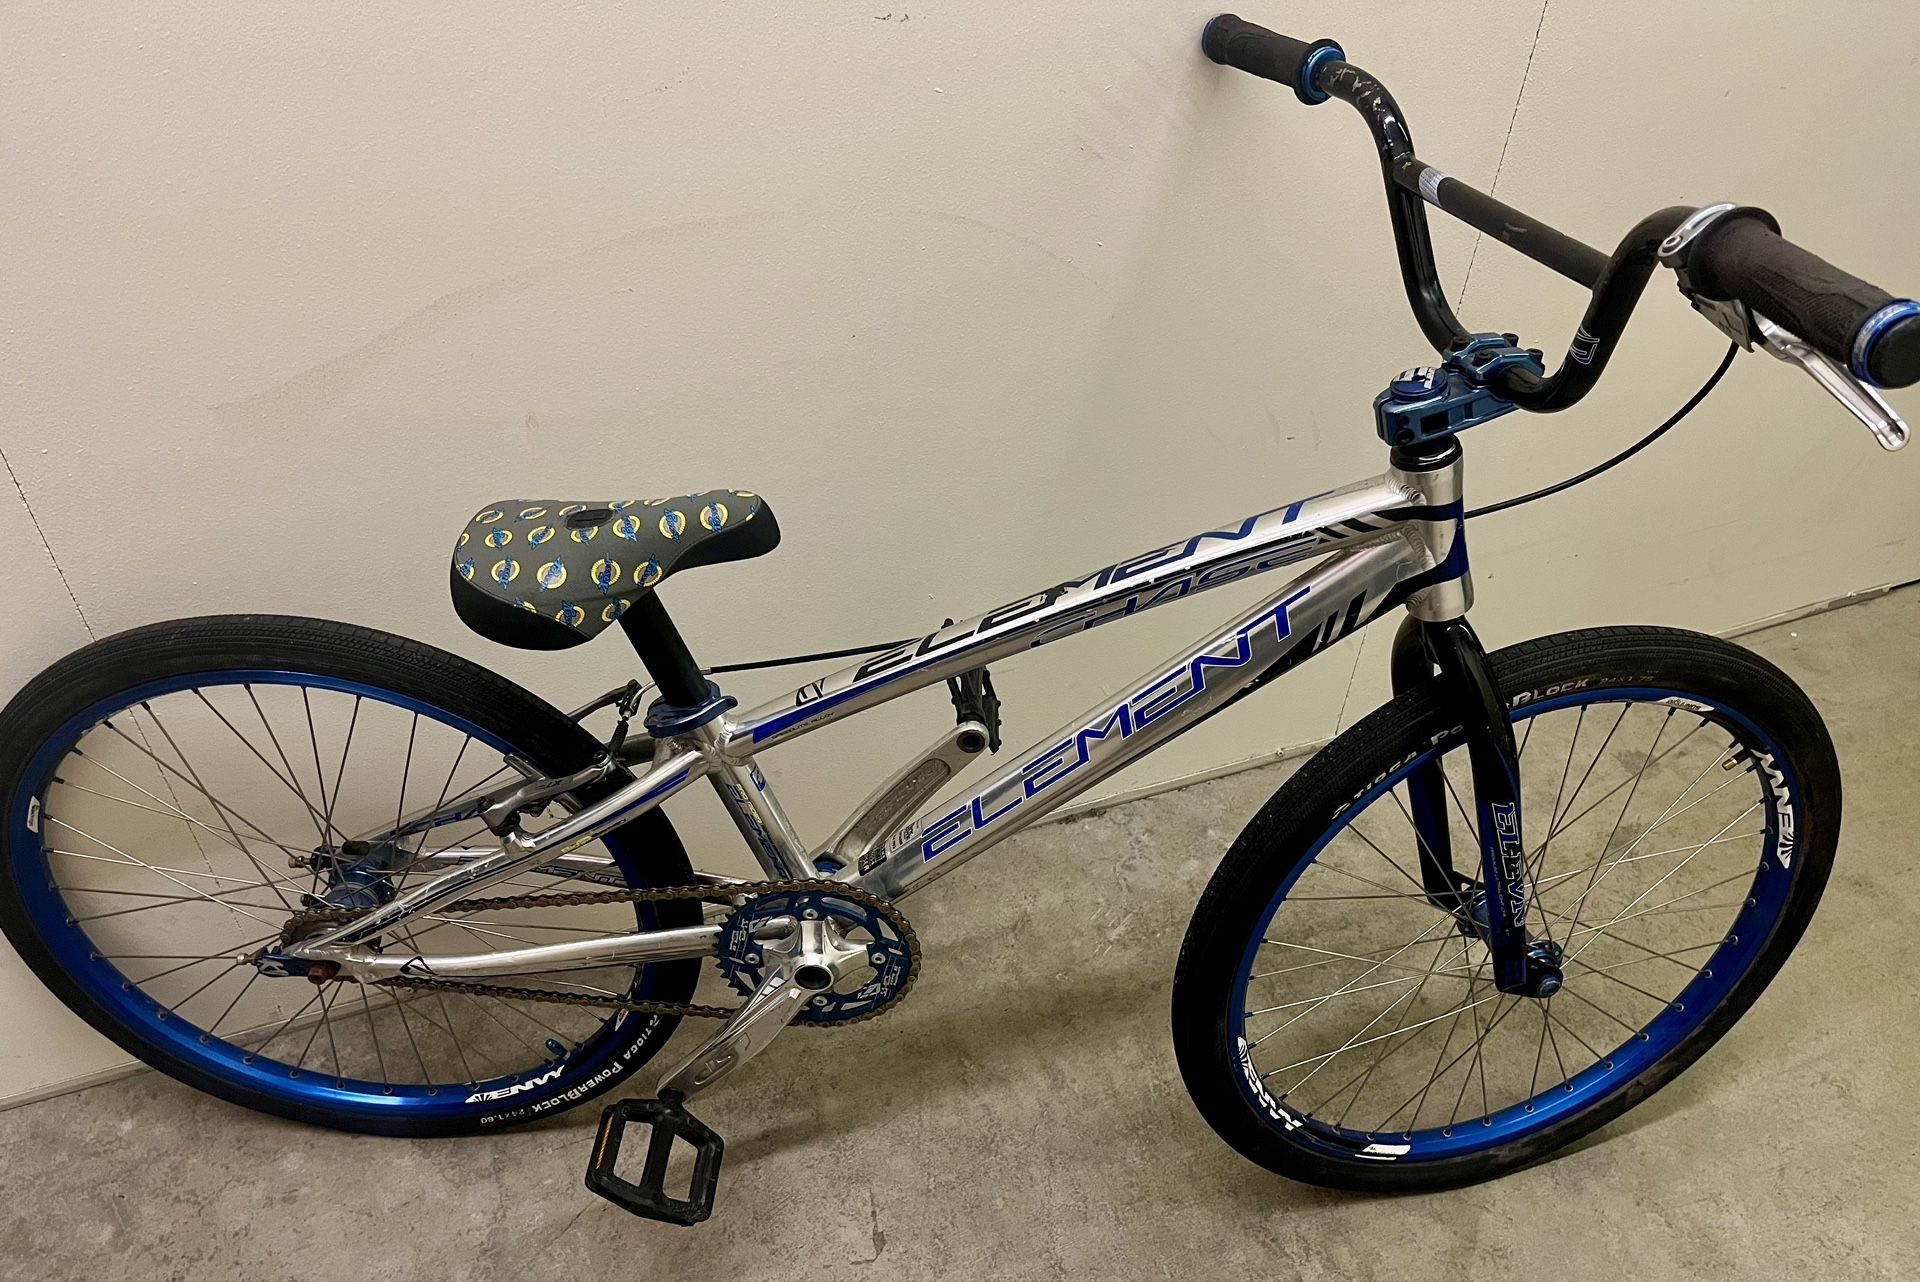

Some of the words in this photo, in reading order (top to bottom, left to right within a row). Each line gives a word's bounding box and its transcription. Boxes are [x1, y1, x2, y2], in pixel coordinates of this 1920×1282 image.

[854, 490, 1334, 683] ELEMENT
[921, 585, 1311, 863] ELEMENT
[1354, 751, 1417, 799] TIOGA
[623, 1028, 654, 1061] TIOGA
[489, 1065, 565, 1099] ENVY
